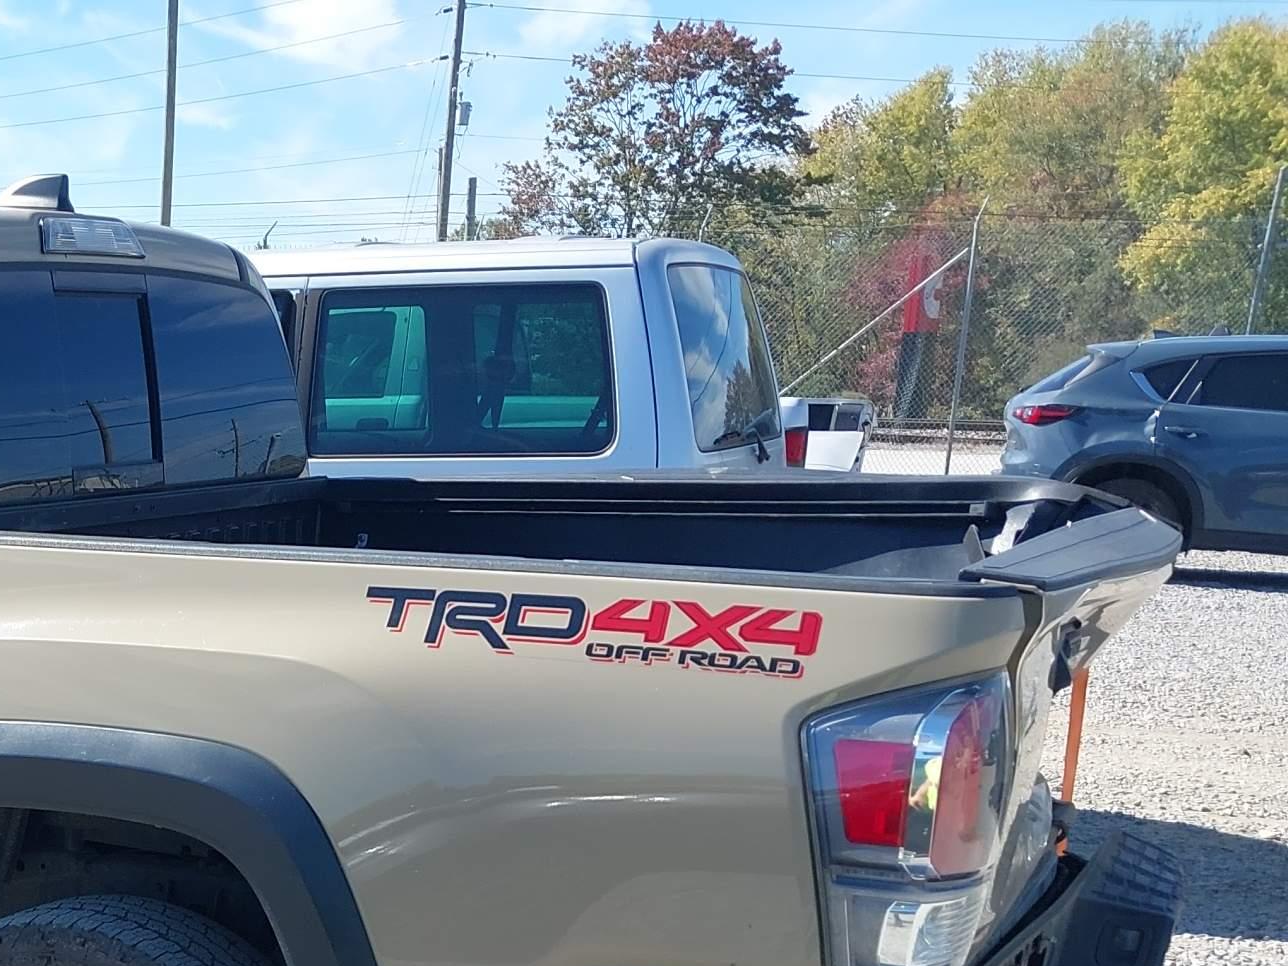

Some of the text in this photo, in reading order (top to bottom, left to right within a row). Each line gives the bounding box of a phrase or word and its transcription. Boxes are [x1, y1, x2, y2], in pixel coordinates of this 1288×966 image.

[365, 586, 824, 657] TRD 4X4
[585, 642, 804, 679] OFF ROAD
